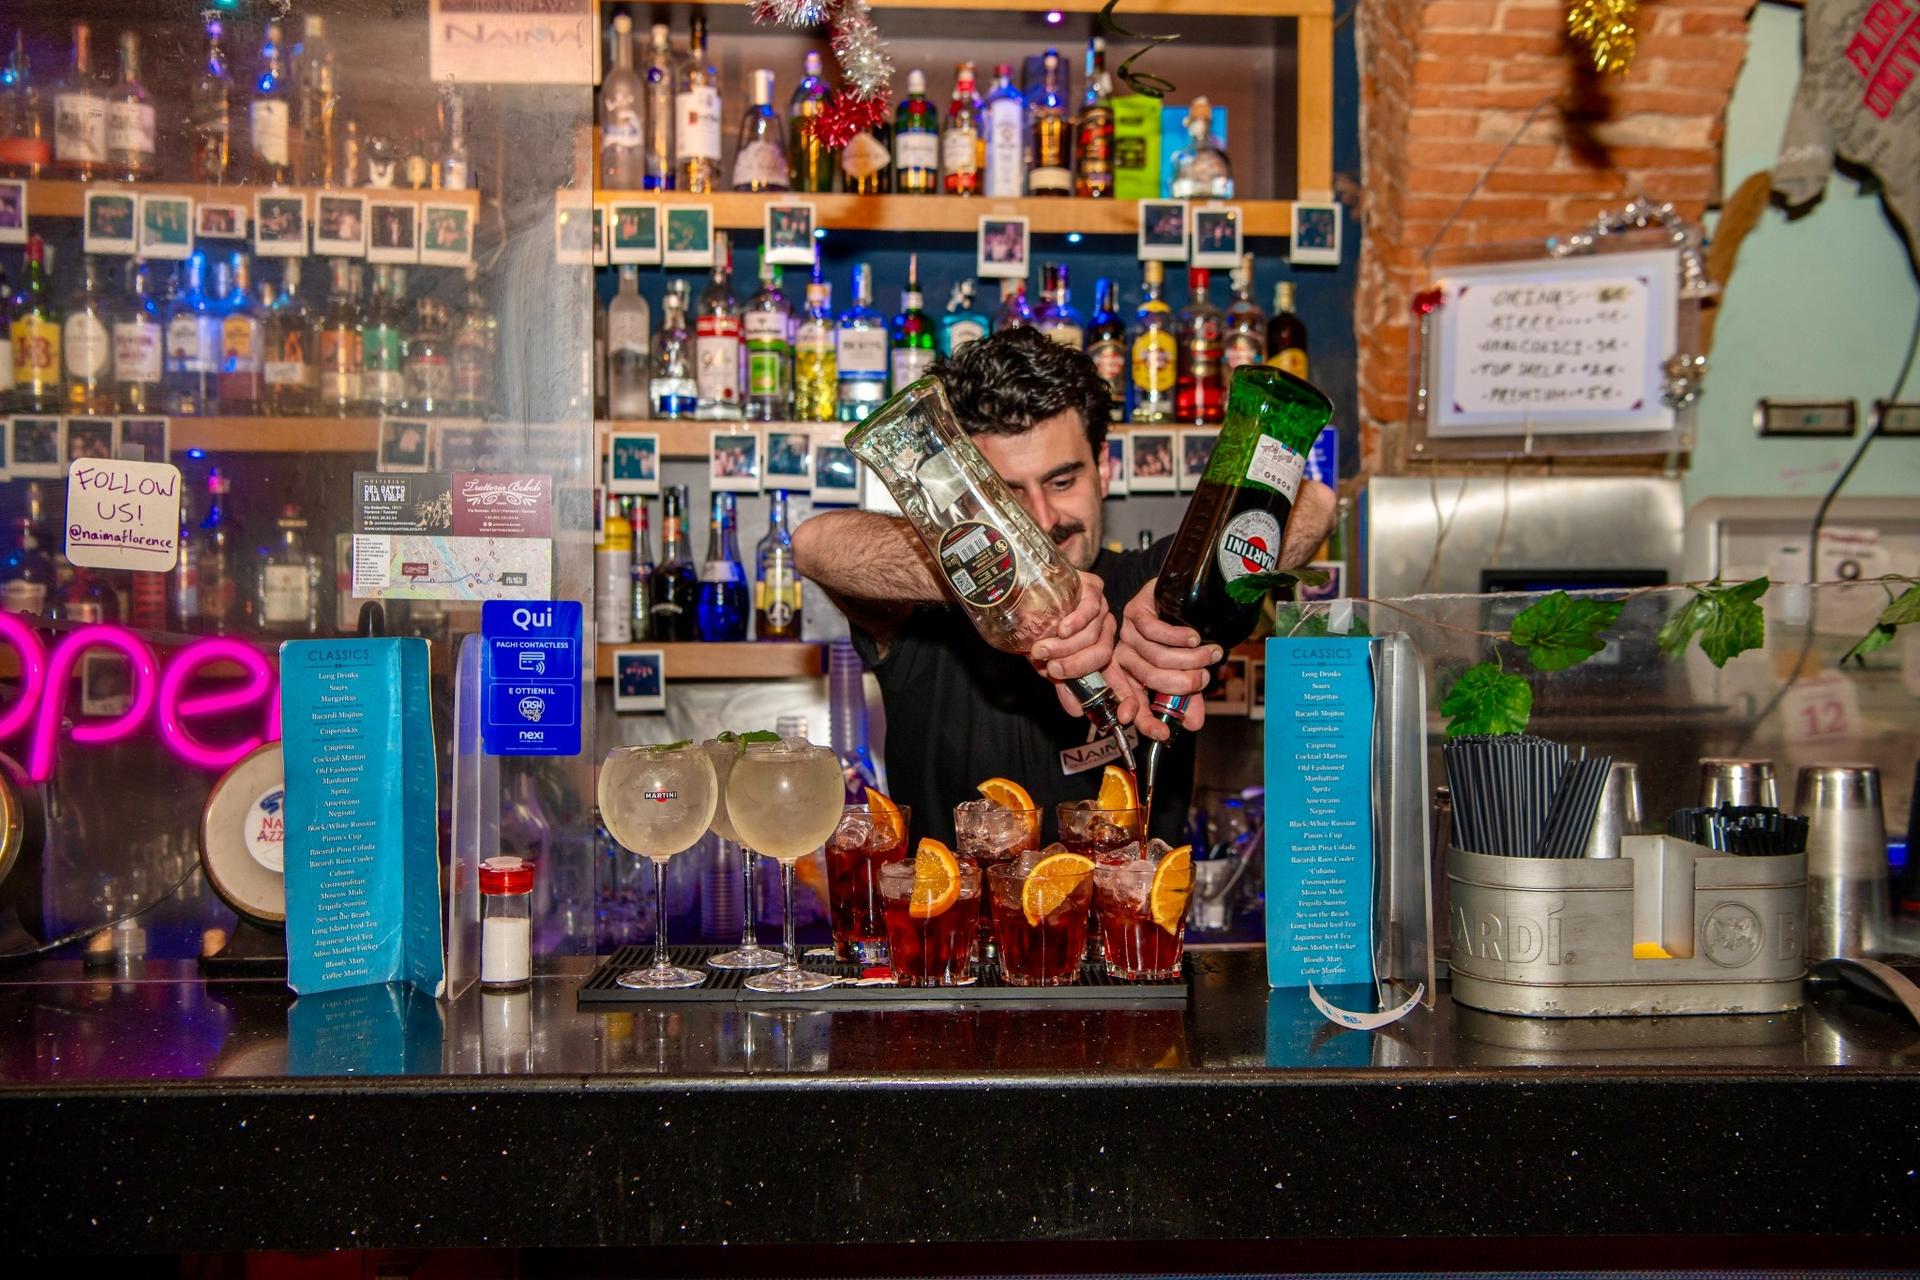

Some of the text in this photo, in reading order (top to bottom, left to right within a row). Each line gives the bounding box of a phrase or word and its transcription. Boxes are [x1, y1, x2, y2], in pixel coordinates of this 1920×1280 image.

[445, 23, 581, 47] NAIMA
[75, 468, 176, 496] FOLLOW
[463, 479, 506, 492] Trattoria
[1264, 471, 1291, 492] ROSSO
[97, 502, 144, 526] US!
[69, 524, 173, 549] @naimaflorence
[1227, 535, 1274, 570] MARTINI
[513, 608, 552, 631] Qui
[308, 649, 370, 661] CLASSICS
[1292, 649, 1352, 659] CLASSICS
[1302, 671, 1318, 679] Long
[0, 612, 281, 782] pe
[321, 695, 357, 703] Margaritas
[1304, 693, 1338, 701] Margaritas
[522, 700, 542, 709] CASH
[1801, 700, 1847, 737] 12
[519, 731, 543, 739] nexi
[329, 765, 363, 773] Fashioned
[330, 788, 350, 796] Spritz
[1312, 786, 1331, 794] Spritz
[323, 799, 360, 807] Americano
[328, 809, 355, 818] Negroni
[348, 833, 362, 841] Cup
[1329, 832, 1342, 840] Cup
[310, 848, 335, 856] Bacardi
[310, 859, 335, 868] Bacardi
[353, 855, 374, 863] Cooler
[1334, 855, 1355, 863] Cooler
[320, 879, 365, 889] Cosmopolitan
[1302, 878, 1346, 886] Cosmopolitan
[348, 889, 365, 897] Mule
[318, 899, 367, 912] Tequila Sunrise
[339, 912, 350, 920] the
[311, 928, 328, 936] Long
[329, 925, 349, 933] Island
[1291, 922, 1307, 930] Long
[1450, 899, 1566, 966] ARDÍ
[315, 937, 346, 947] Japanese
[362, 933, 373, 941] Tea
[1294, 934, 1322, 942] Japanese
[333, 946, 356, 955] Mother
[325, 957, 365, 969] Bloody Mary
[1304, 956, 1324, 964] Bloody
[322, 969, 369, 980] Coffee Martini
